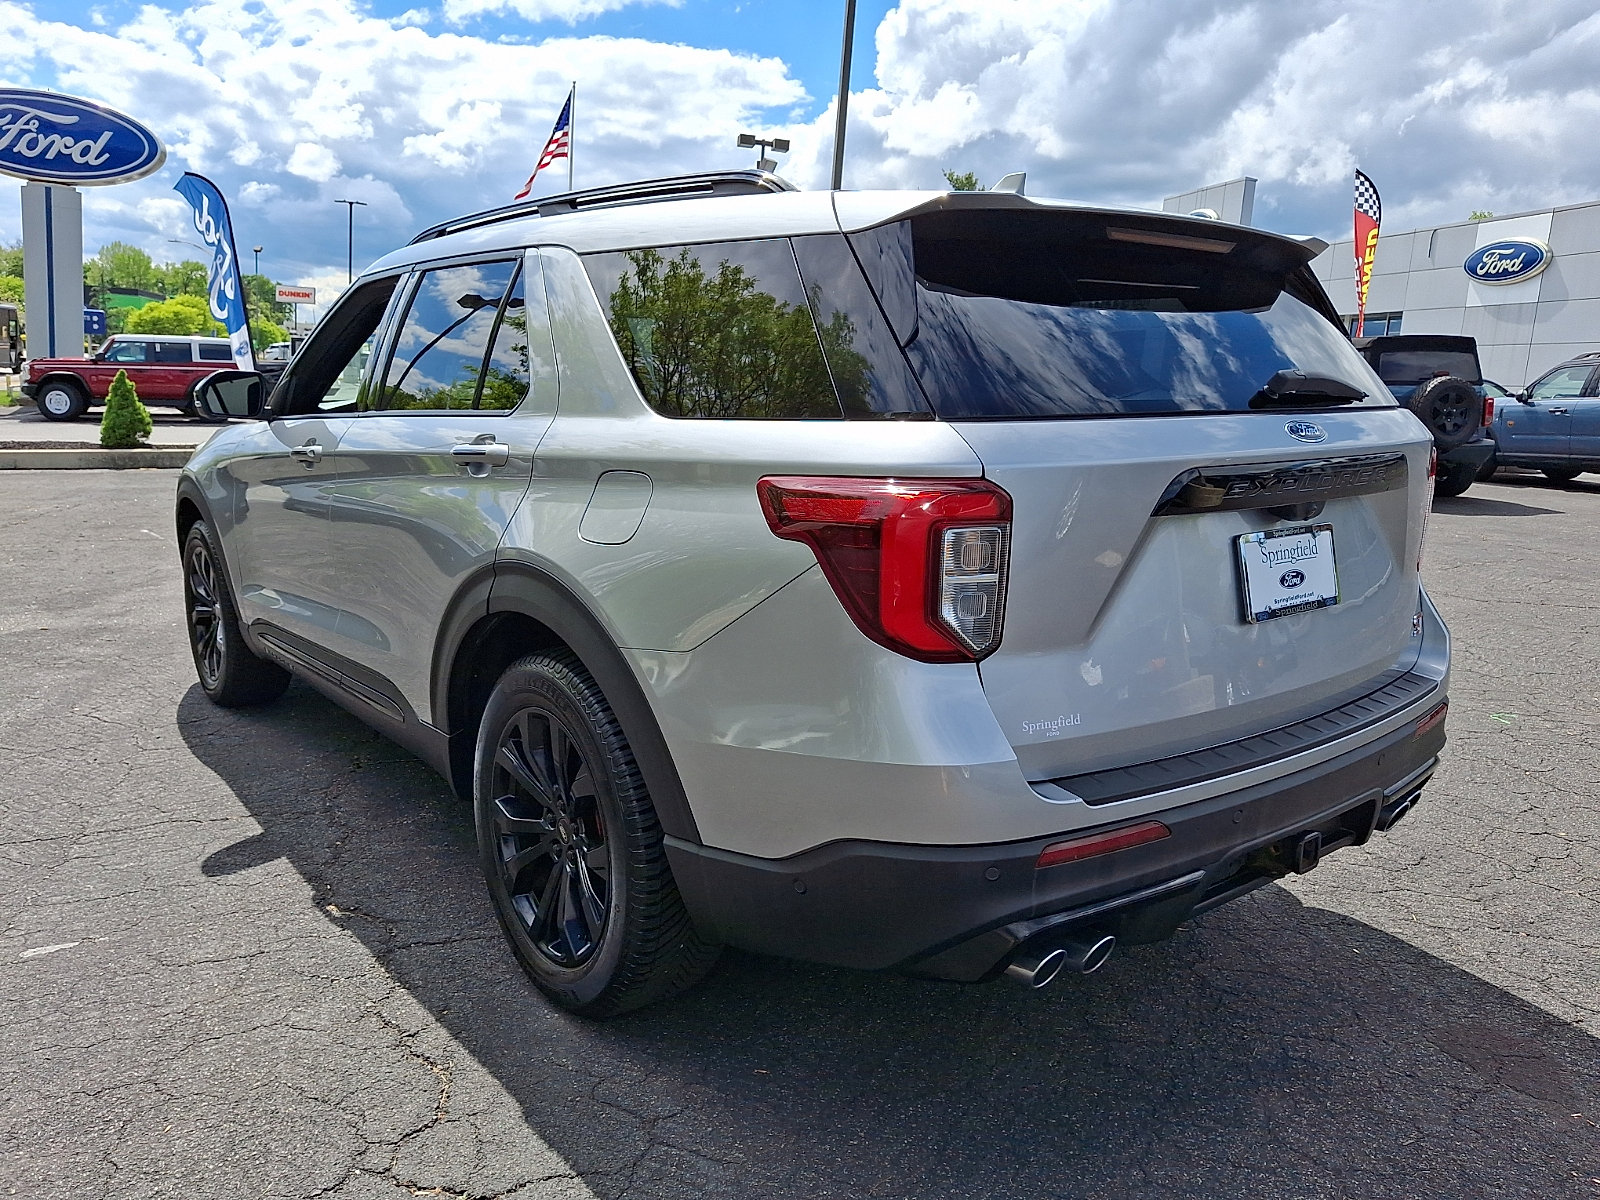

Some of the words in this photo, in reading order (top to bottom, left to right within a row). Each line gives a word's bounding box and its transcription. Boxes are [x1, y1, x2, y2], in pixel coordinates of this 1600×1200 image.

[0, 104, 114, 166] Ford
[1476, 248, 1527, 275] Ford
[278, 290, 313, 299] DUNKIN'
[1222, 466, 1387, 499] EXPLORER
[1260, 538, 1319, 569] Springfield
[1283, 572, 1302, 587] Ford
[1275, 601, 1319, 617] Springfield
[1022, 713, 1081, 735] Springfield
